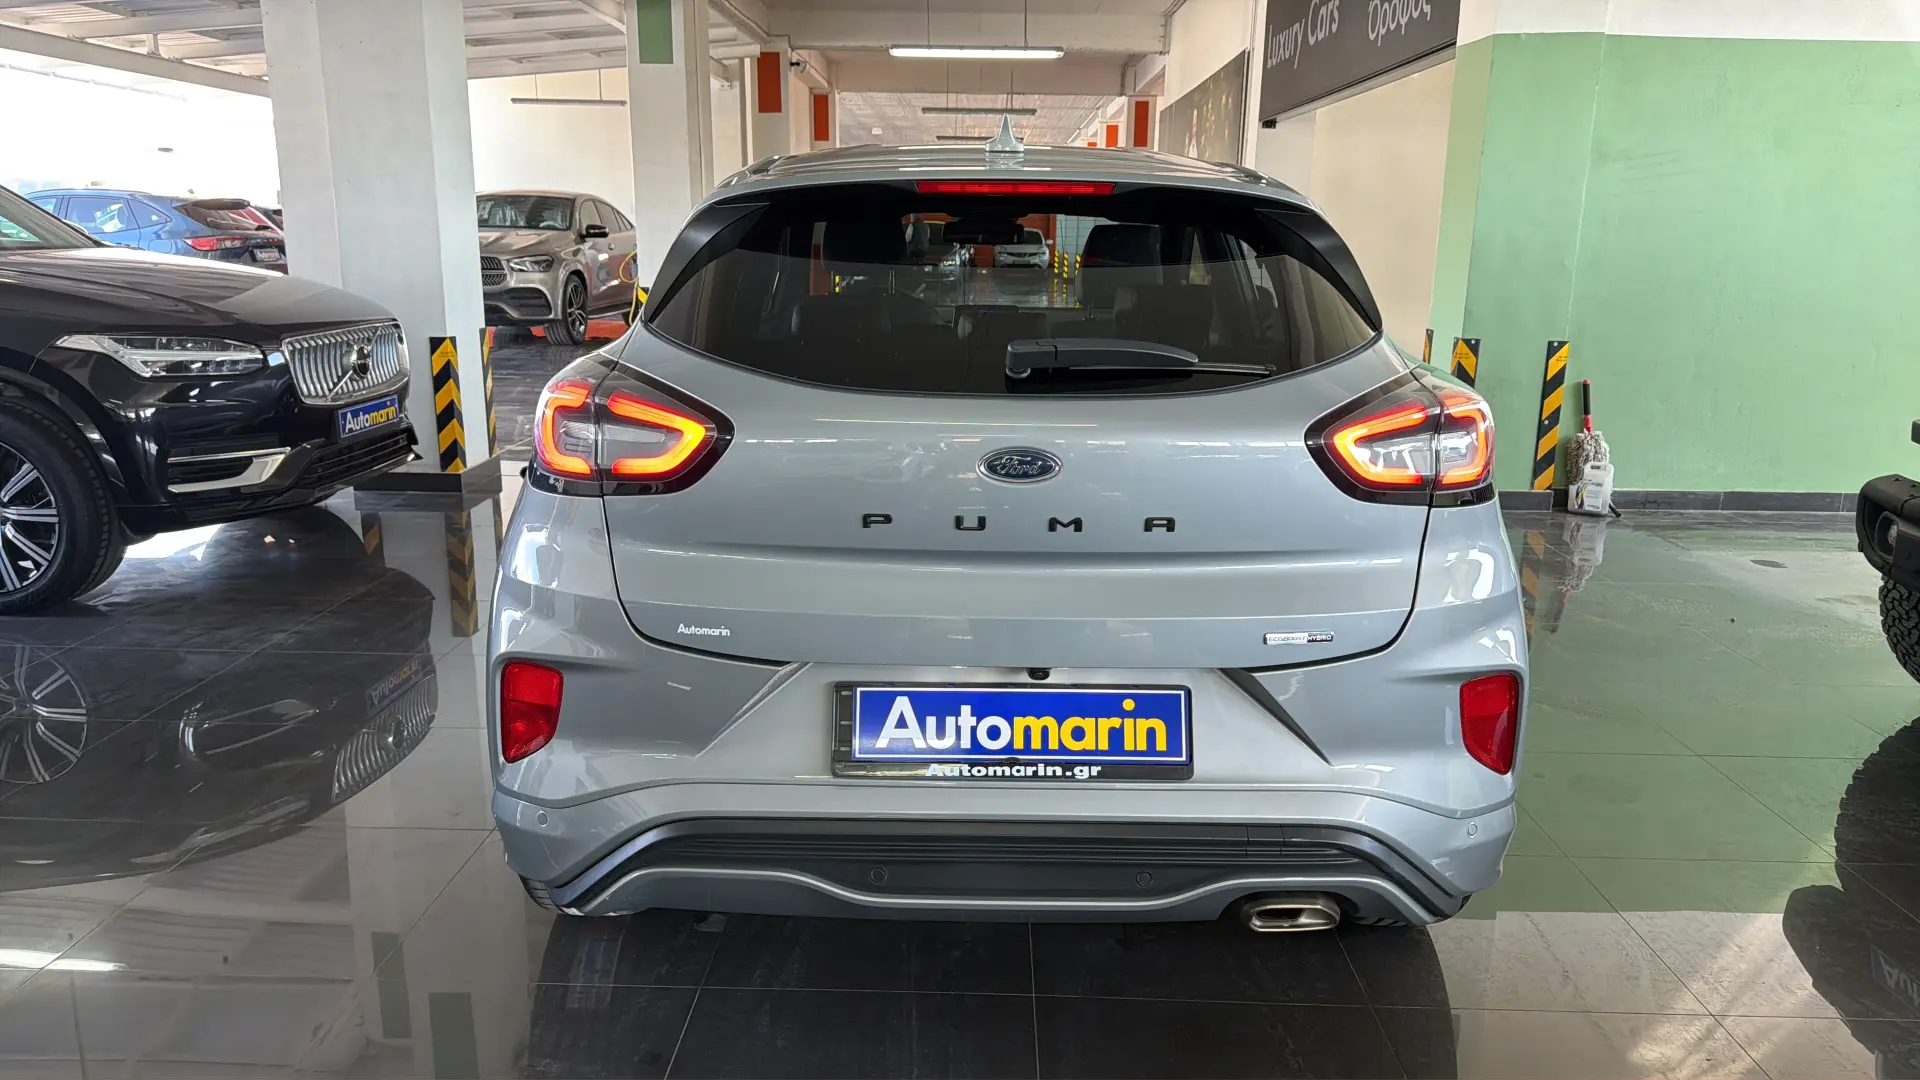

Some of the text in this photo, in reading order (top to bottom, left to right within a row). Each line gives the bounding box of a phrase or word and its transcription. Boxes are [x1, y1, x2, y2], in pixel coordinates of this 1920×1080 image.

[1267, 0, 1339, 69] Luxury Cars
[345, 400, 397, 433] Automarin
[997, 455, 1042, 477] Ford
[862, 513, 1176, 533] PUMA
[677, 623, 731, 637] Automarin
[874, 695, 1168, 752] Automarin
[925, 763, 1102, 779] Automarin.gr
